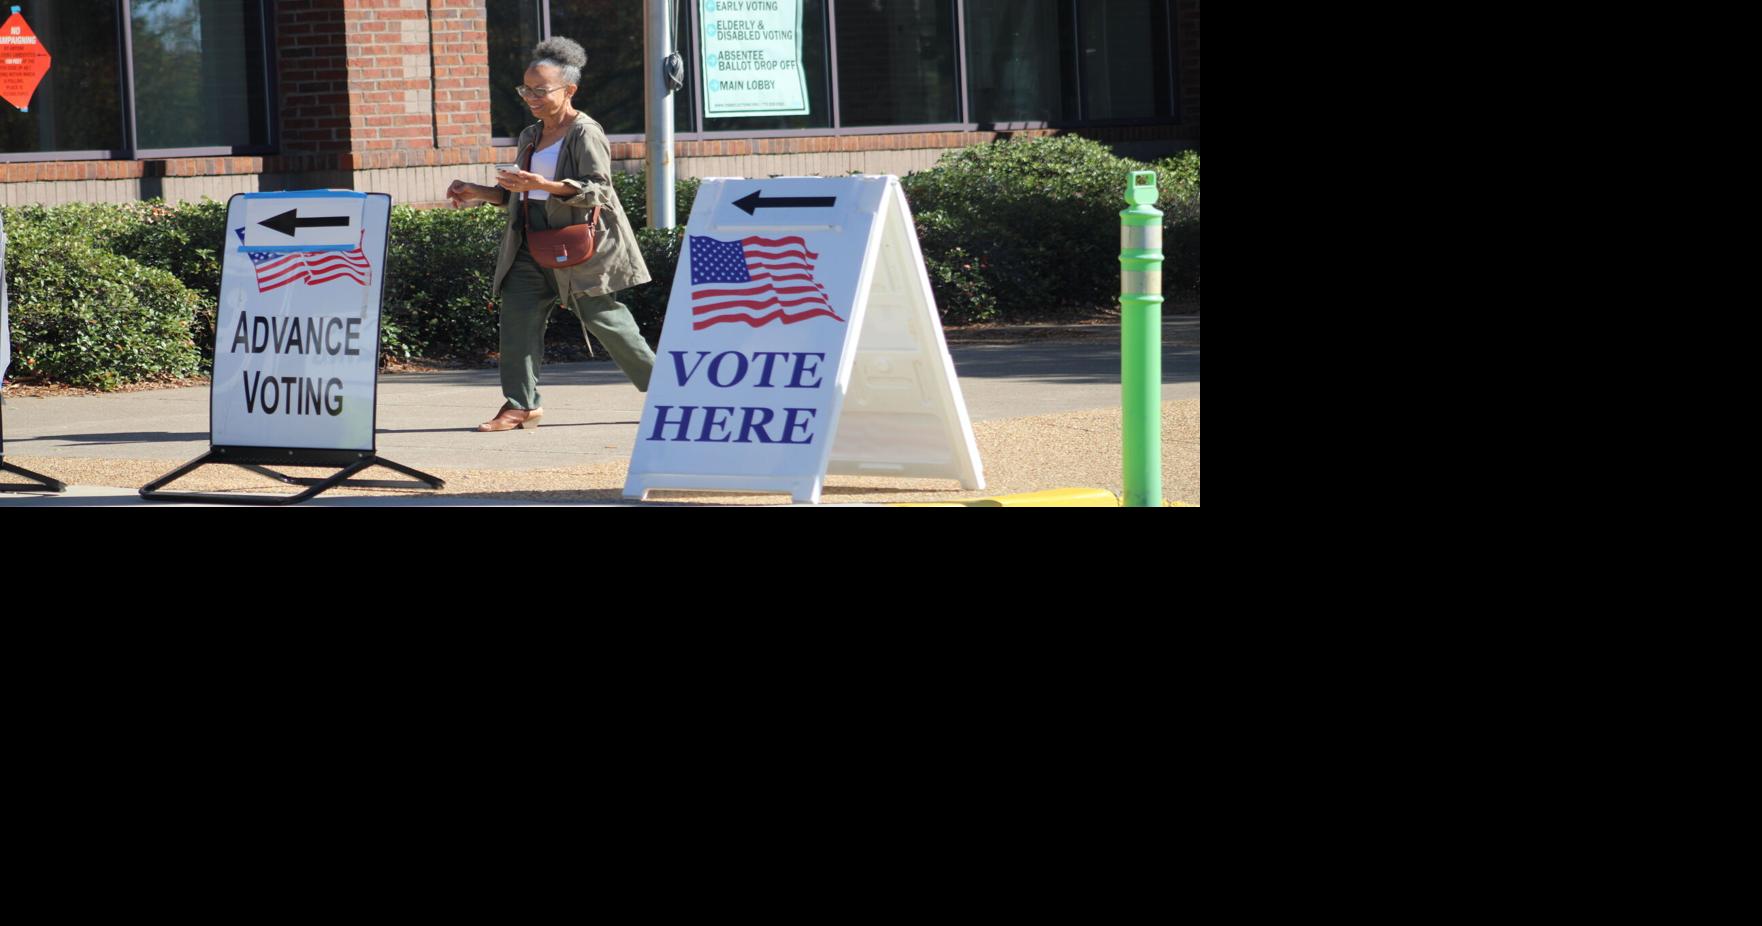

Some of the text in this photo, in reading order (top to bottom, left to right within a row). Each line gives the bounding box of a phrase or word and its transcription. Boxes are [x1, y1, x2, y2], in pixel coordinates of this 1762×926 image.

[716, 1, 778, 11] EARLY VOTING
[717, 20, 765, 30] ELDERLY &
[10, 26, 21, 35] NO
[717, 30, 793, 40] DISABLED VOTING
[0, 36, 37, 44] AMPAIGNING
[718, 50, 764, 60] ABSENTEE
[718, 60, 797, 71] BALLOT DROP OFF
[720, 80, 776, 91] MAIN LOBBY
[230, 310, 362, 356] ADVANCE
[668, 350, 826, 389] VOTE
[243, 370, 344, 417] VOTING
[645, 405, 817, 444] HERE
